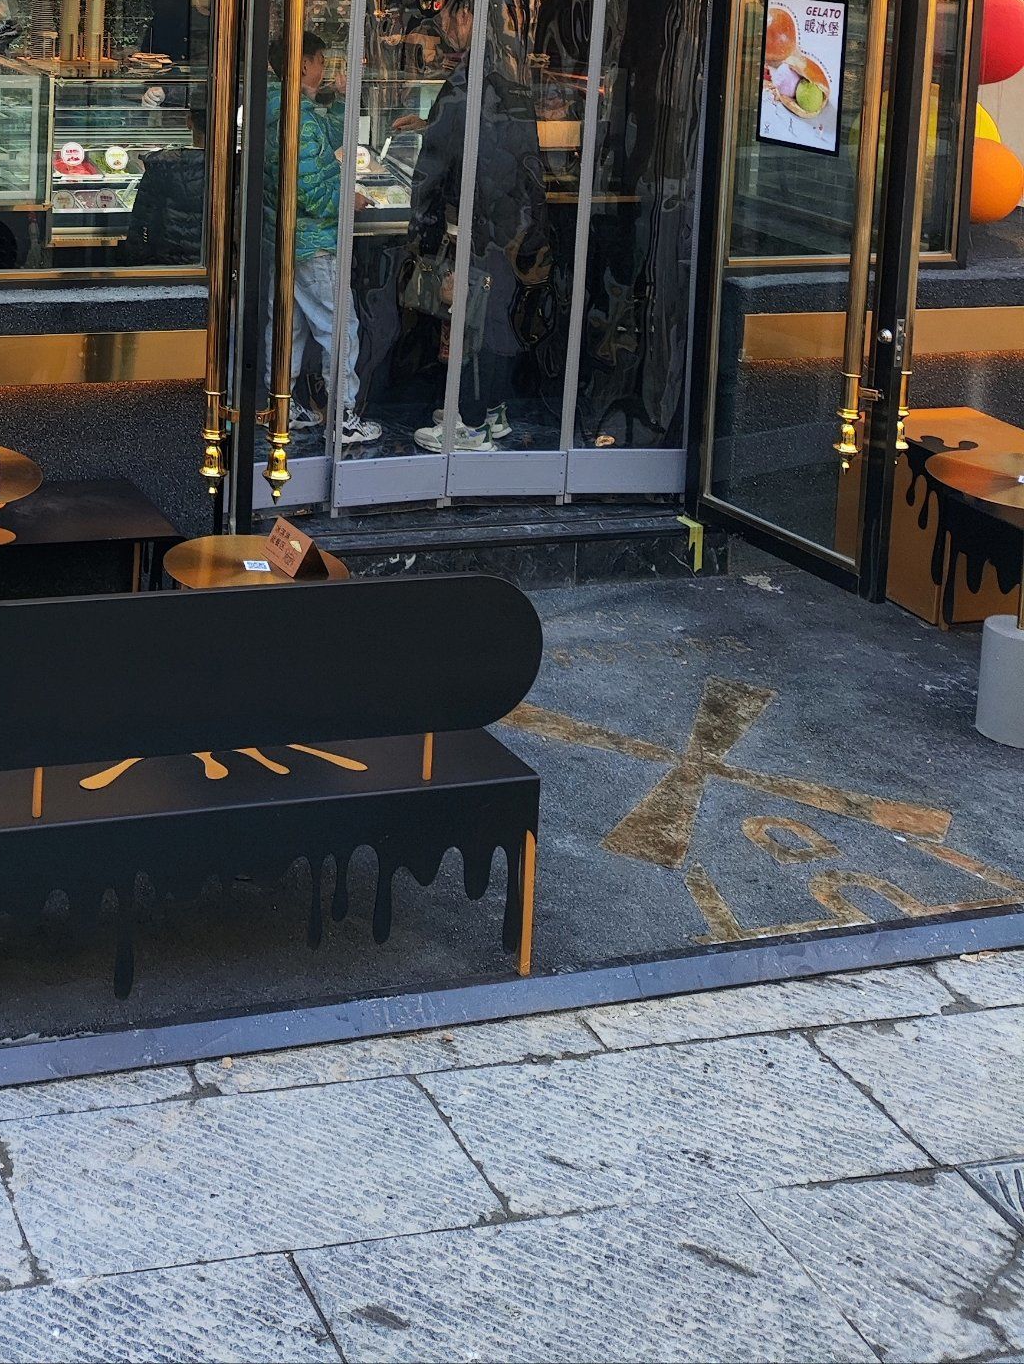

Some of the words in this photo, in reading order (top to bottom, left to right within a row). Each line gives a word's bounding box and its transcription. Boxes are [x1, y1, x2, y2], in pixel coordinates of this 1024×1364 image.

[805, 6, 842, 19] GELATO
[804, 19, 840, 37] 暖冰堡
